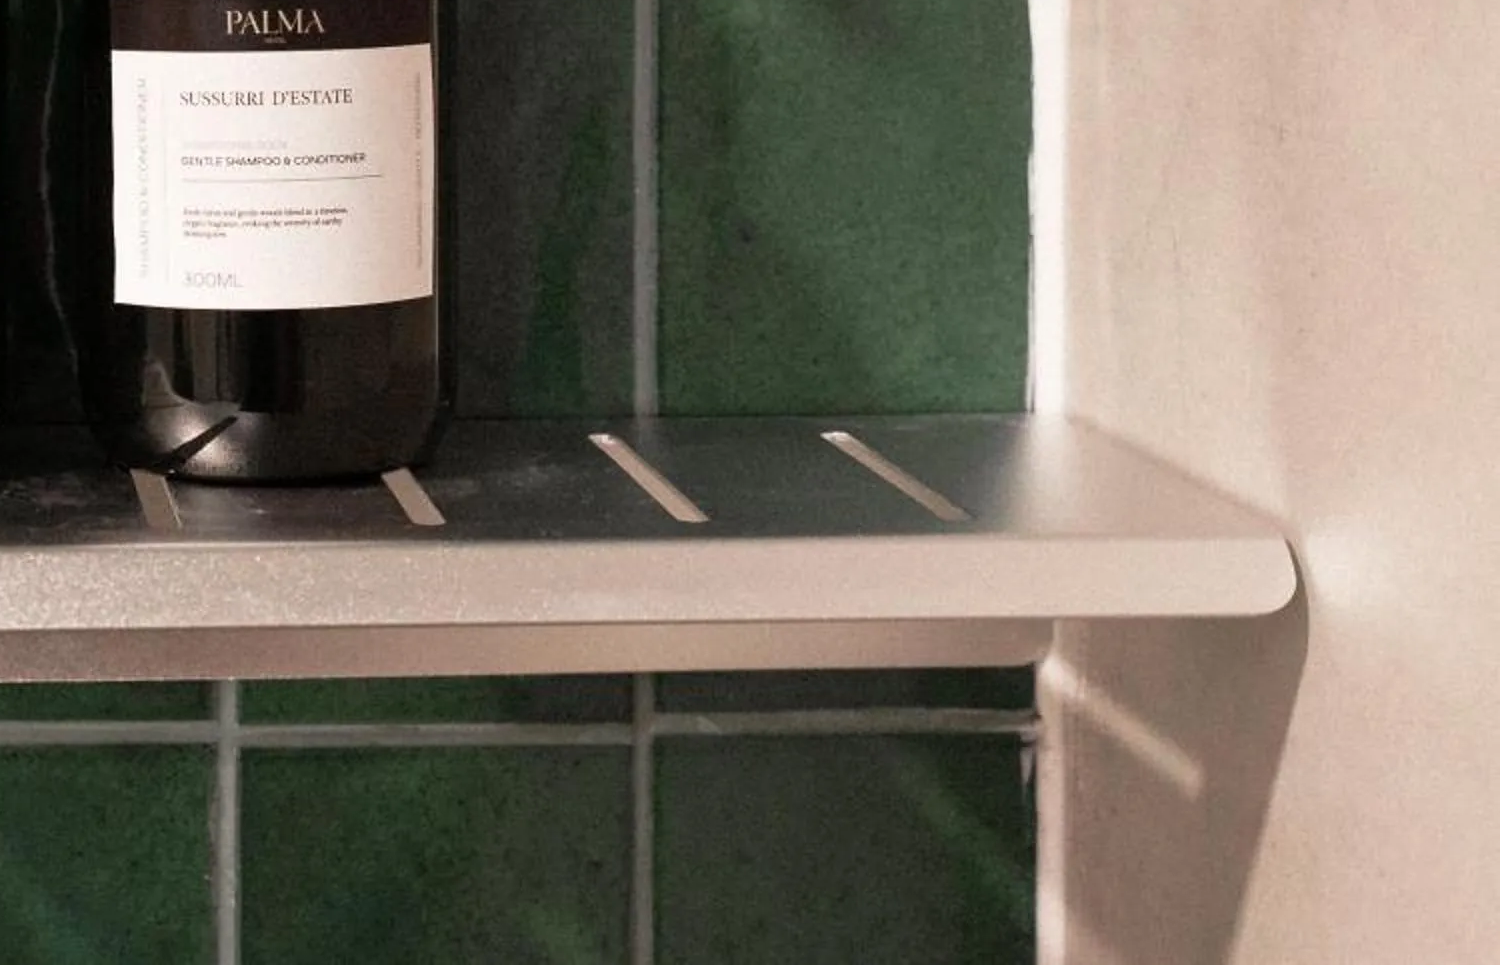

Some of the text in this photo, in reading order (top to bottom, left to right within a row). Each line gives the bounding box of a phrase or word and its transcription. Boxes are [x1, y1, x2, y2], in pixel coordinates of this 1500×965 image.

[226, 9, 325, 35] PALMA
[179, 88, 353, 107] SUSSURRI D'ESTATE
[181, 156, 226, 167] GENTLE
[226, 155, 281, 167] SHAMPOO
[293, 152, 367, 166] CONDITIONER
